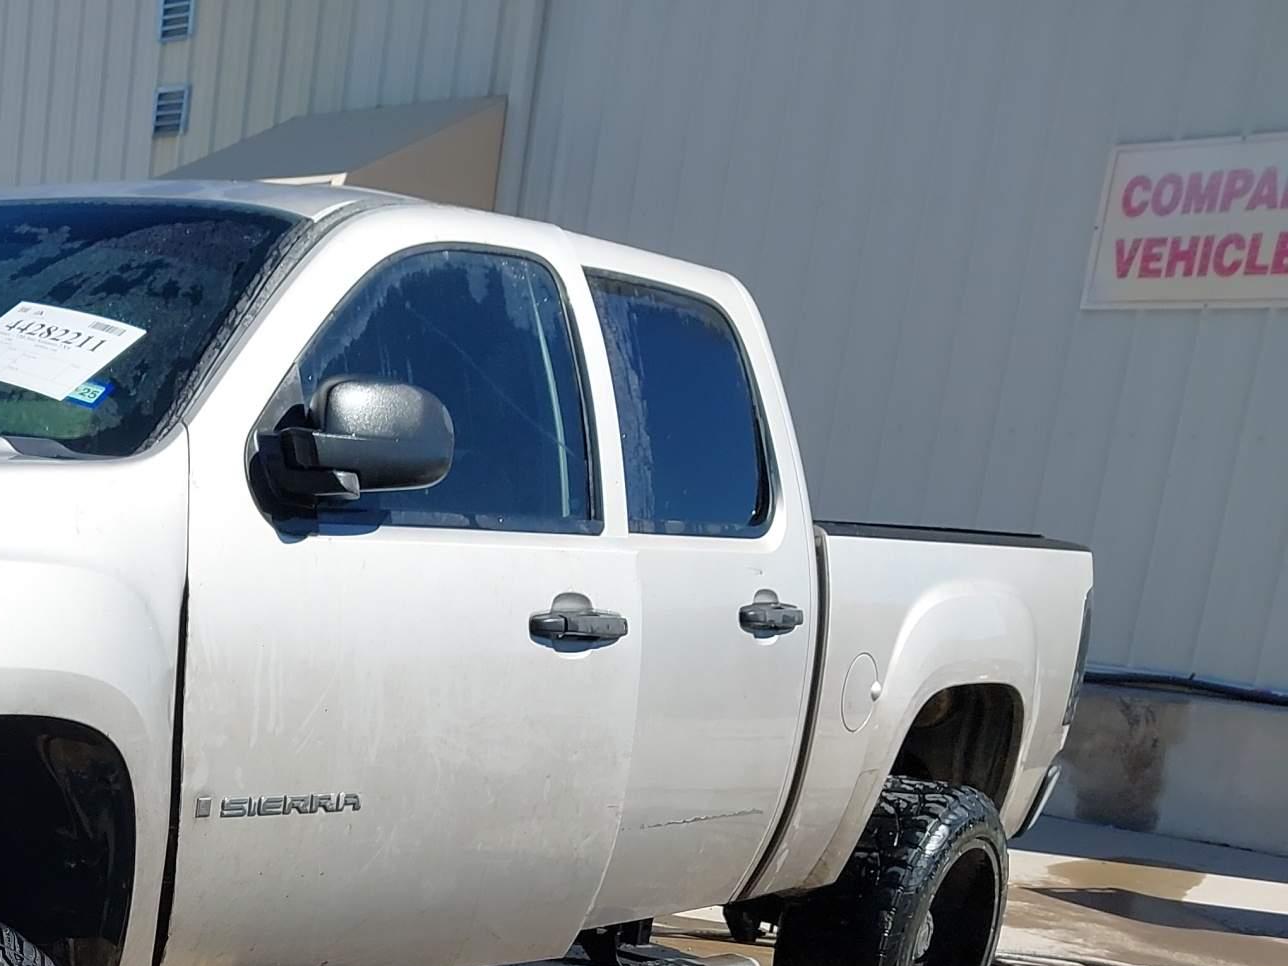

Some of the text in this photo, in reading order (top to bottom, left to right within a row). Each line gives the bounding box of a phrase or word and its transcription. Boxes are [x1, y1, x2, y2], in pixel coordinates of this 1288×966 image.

[1121, 165, 1288, 218] COMPA
[5, 319, 107, 353] 44282211
[79, 387, 100, 399] 25
[220, 792, 361, 818] SIERRA
